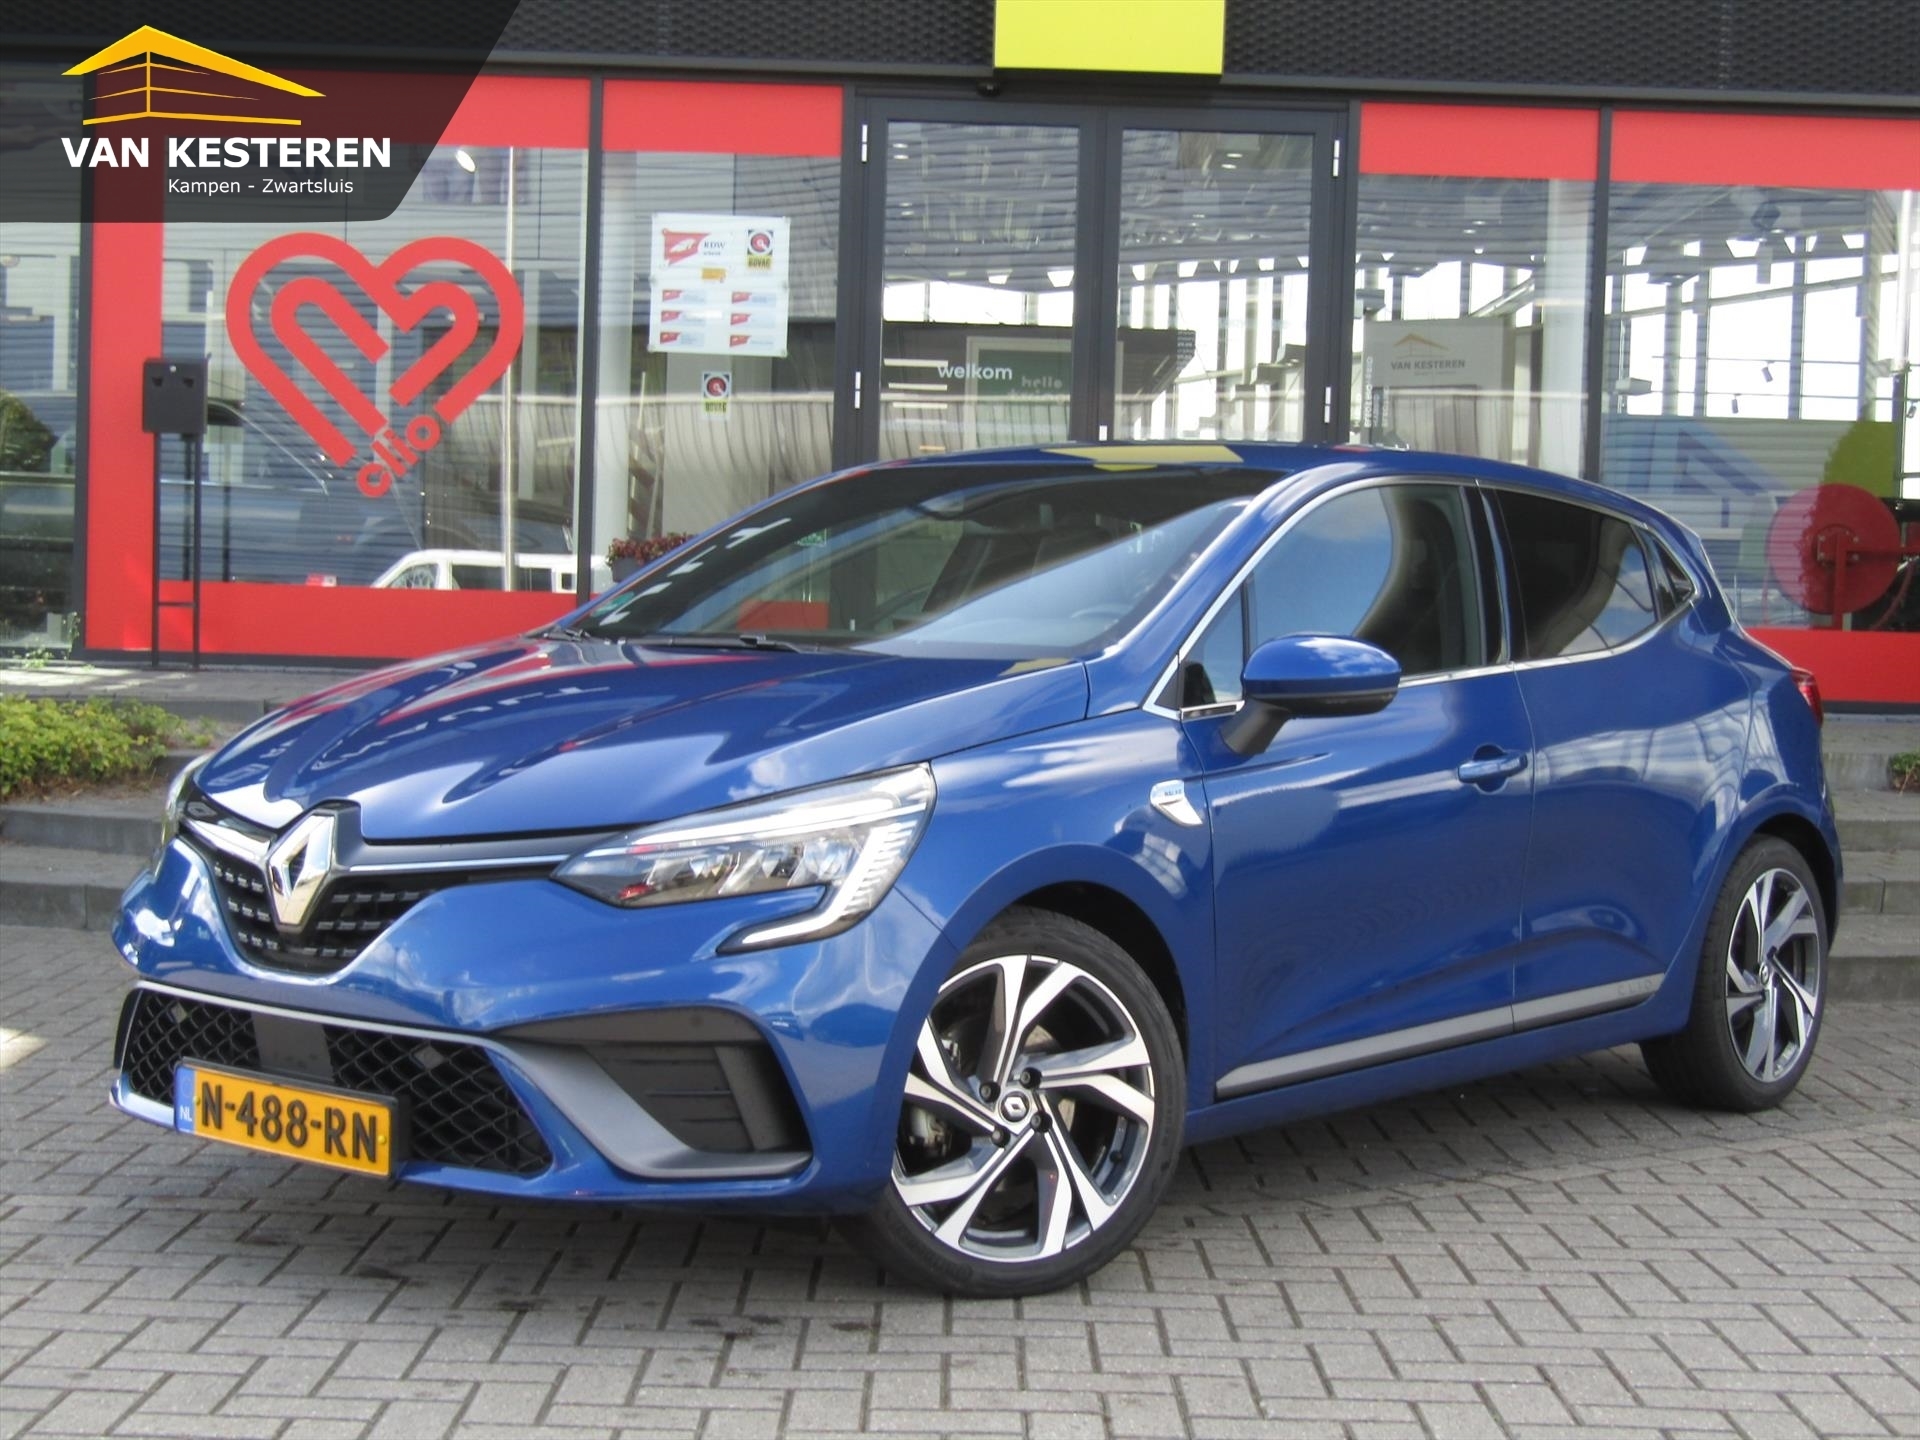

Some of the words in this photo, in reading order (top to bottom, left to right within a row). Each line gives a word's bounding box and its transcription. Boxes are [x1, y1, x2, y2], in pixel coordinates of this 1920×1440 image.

[938, 363, 1013, 380] welkom
[1391, 361, 1412, 370] VAN
[1414, 359, 1466, 370] KESTEREN
[356, 415, 442, 498] clio
[179, 1105, 193, 1122] NL
[201, 1081, 377, 1164] N-488-RN
